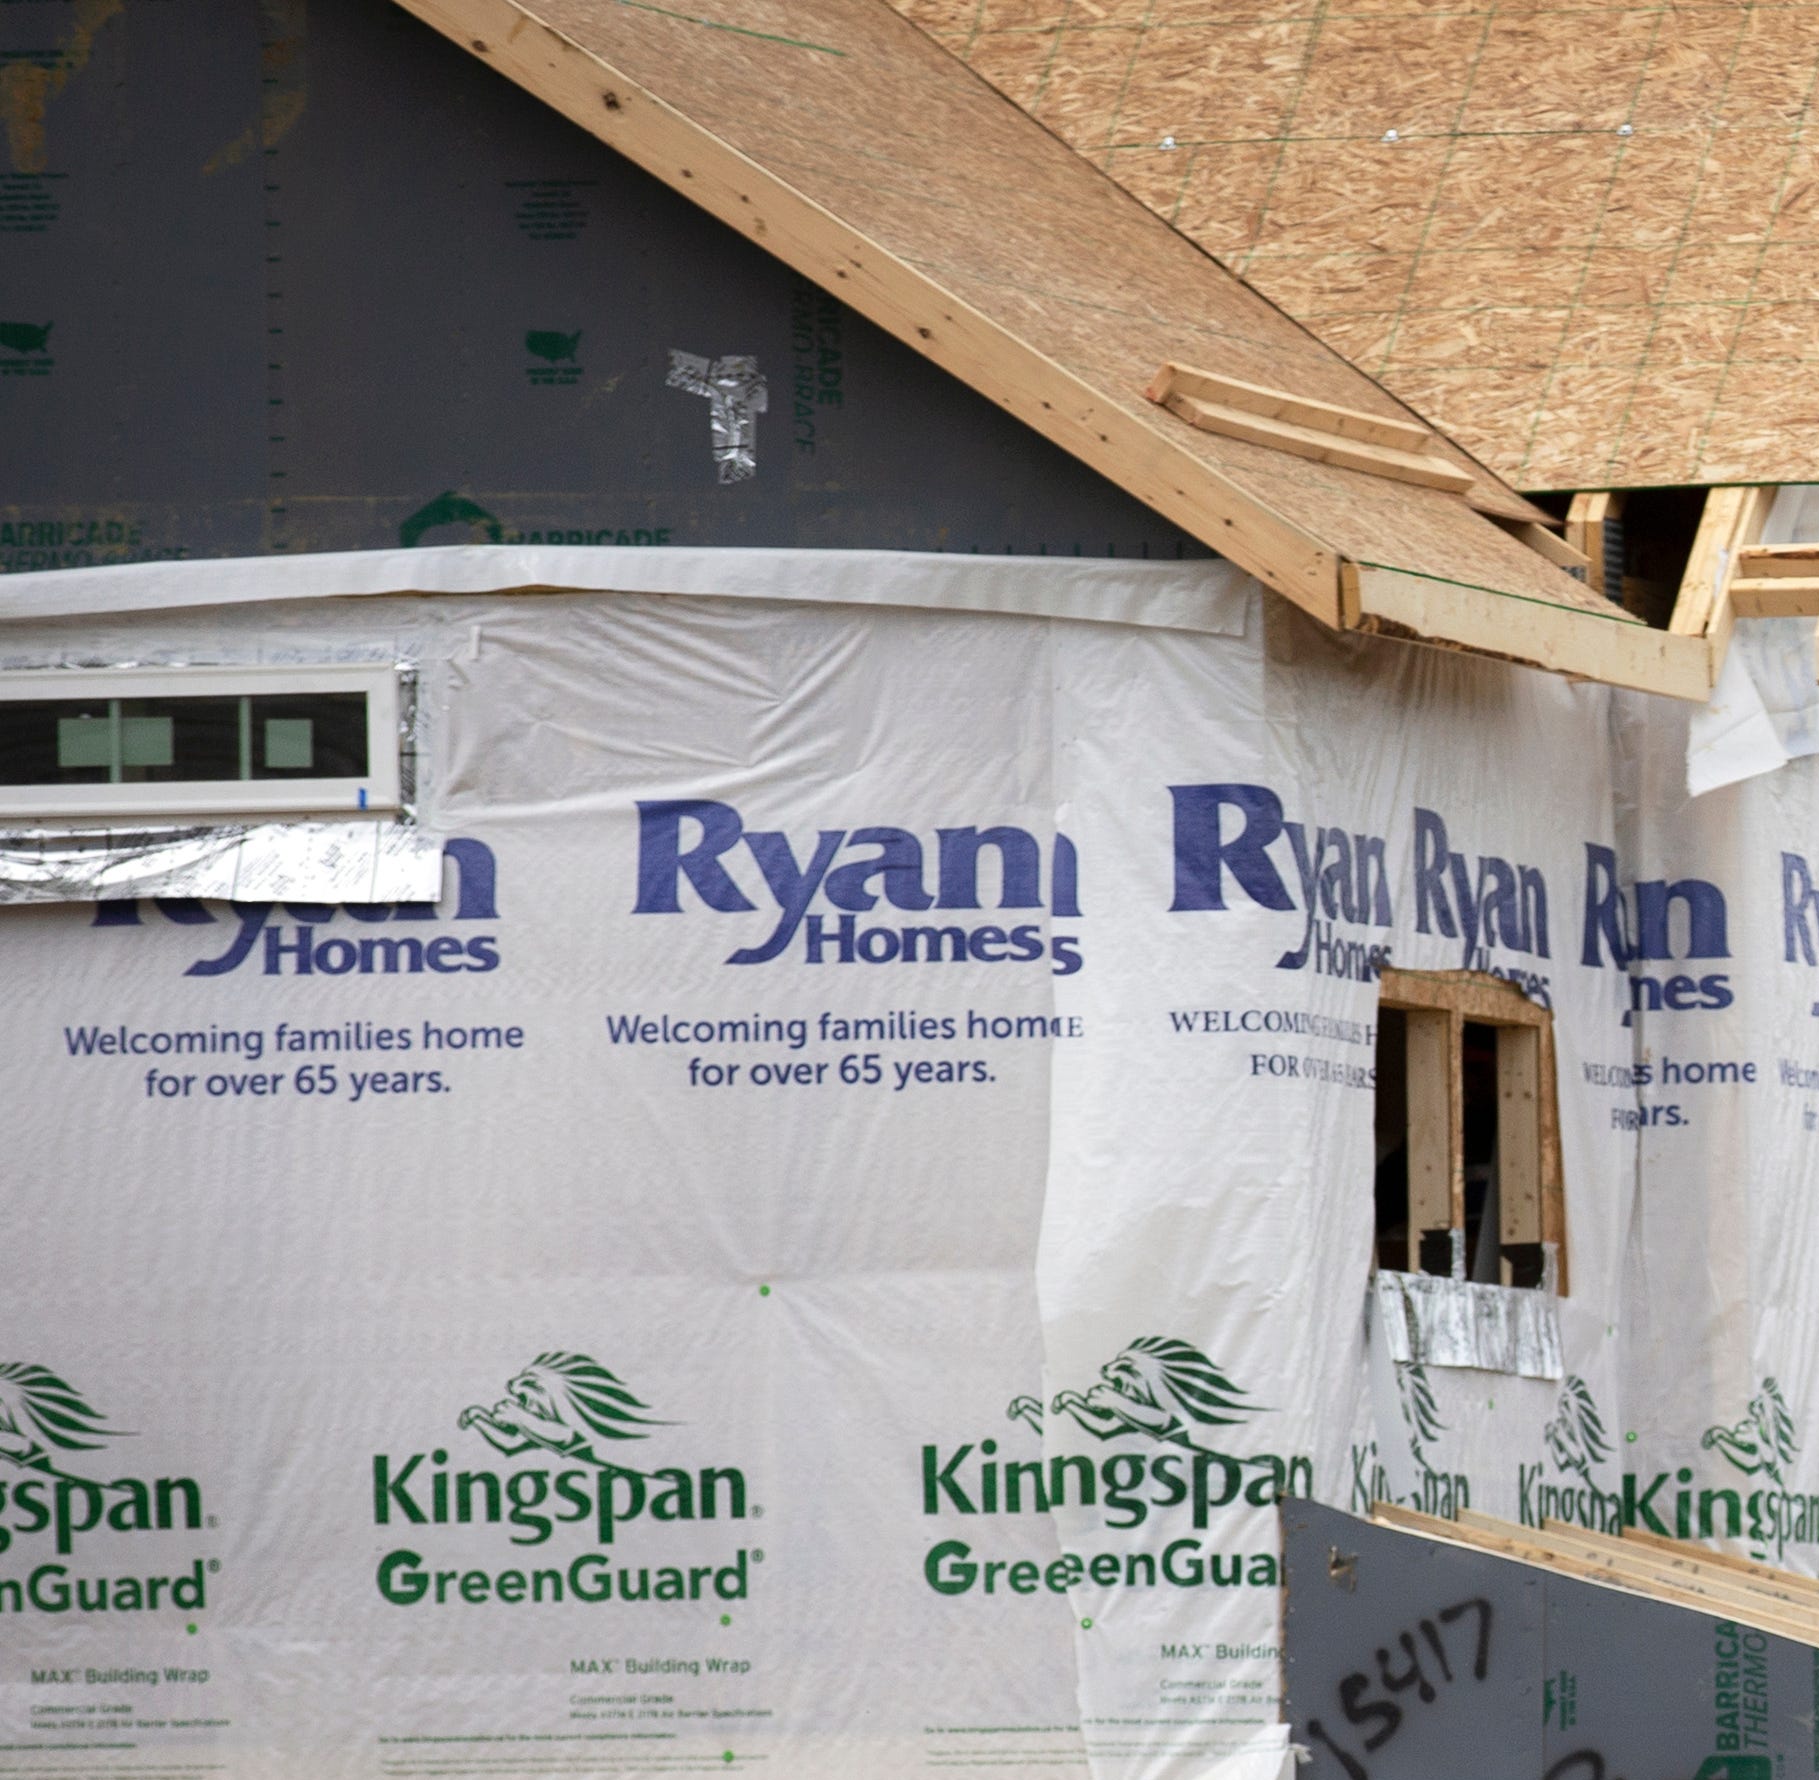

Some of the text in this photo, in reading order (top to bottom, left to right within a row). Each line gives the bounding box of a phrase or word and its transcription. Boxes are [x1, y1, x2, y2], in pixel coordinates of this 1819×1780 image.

[632, 799, 1044, 965] Ryan
[1167, 783, 1392, 968] Ryan
[1414, 806, 1550, 969] Ryan
[260, 921, 500, 975] Homes
[64, 1021, 524, 1060] Welcoming families home
[607, 1011, 956, 1050] Welcoming families
[146, 1065, 450, 1102] for over 65 years.
[689, 1054, 995, 1091] for over 65 years.
[1250, 1053, 1299, 1078] FOR
[1661, 1055, 1758, 1086] home
[373, 1448, 746, 1546] Kingspan
[376, 1549, 748, 1606] GreenGuard
[85, 1668, 159, 1686] Building
[164, 1668, 209, 1683] Wrap
[625, 1658, 700, 1677] Building
[706, 1658, 751, 1674] Wrap
